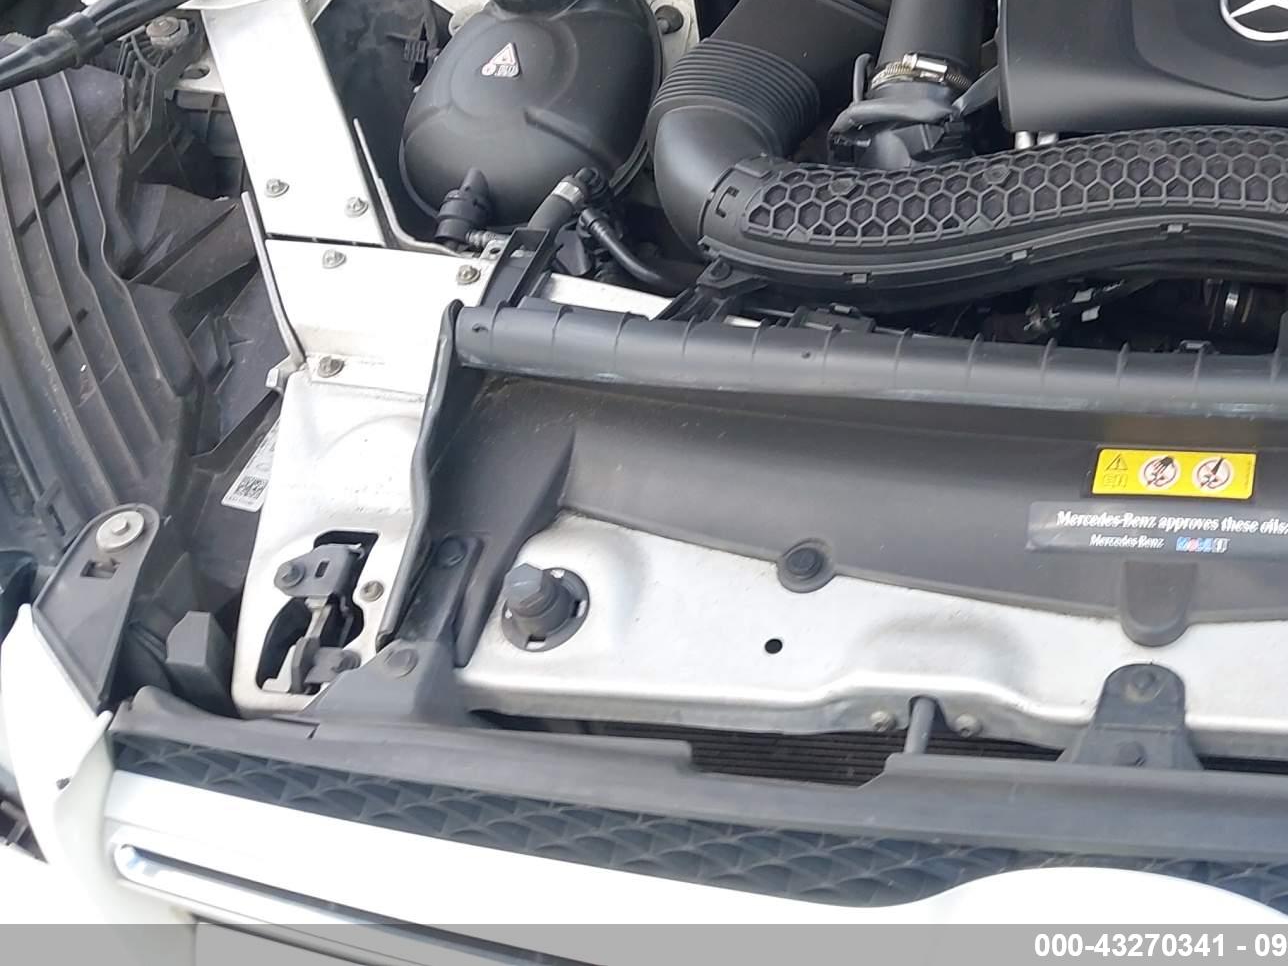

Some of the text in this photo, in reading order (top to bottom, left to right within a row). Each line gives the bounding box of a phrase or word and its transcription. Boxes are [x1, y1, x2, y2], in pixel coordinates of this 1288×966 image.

[1056, 510, 1157, 529] Mercedes-Benz
[1158, 516, 1220, 533] approves
[1221, 516, 1258, 533] these
[1089, 533, 1165, 549] Mercedes-Benz
